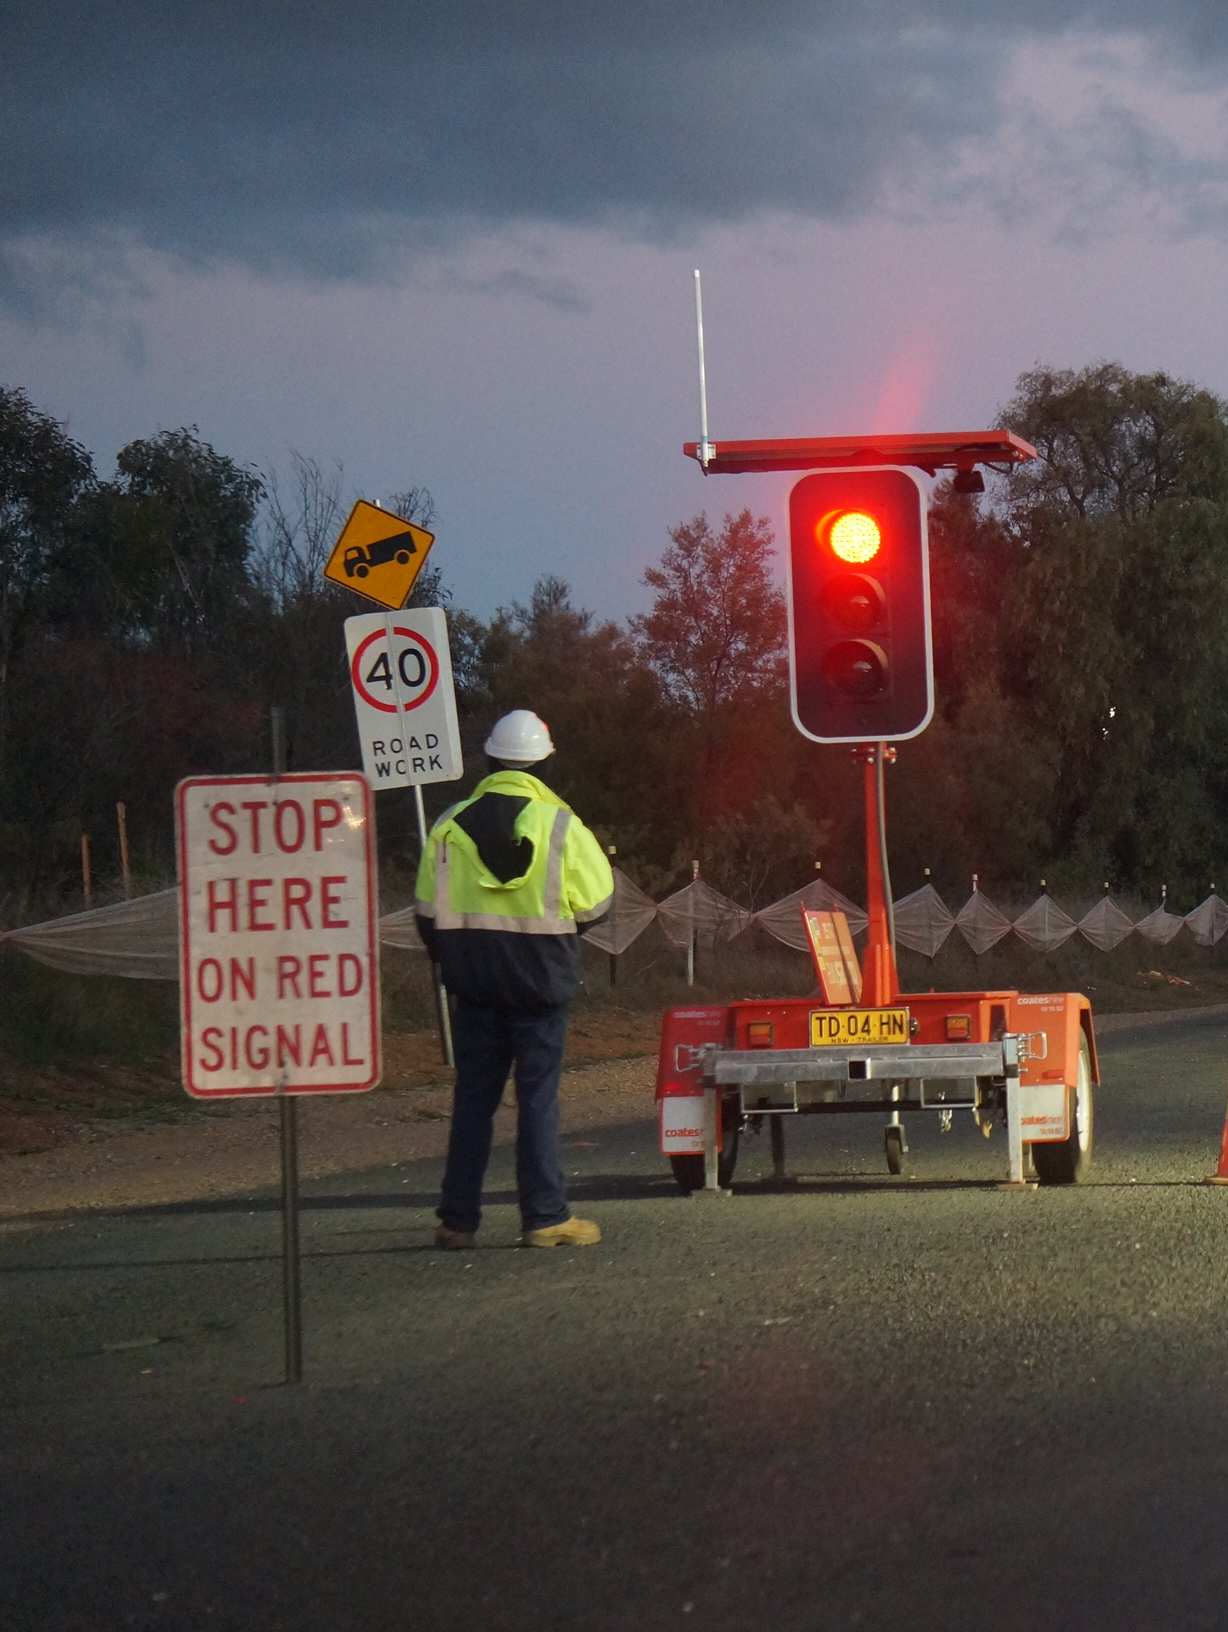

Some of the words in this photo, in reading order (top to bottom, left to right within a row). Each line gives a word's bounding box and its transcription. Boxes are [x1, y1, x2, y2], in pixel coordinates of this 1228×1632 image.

[366, 647, 427, 690] 40
[372, 733, 439, 757] ROAD
[375, 754, 443, 778] WORK
[208, 799, 343, 856] STOP
[207, 875, 350, 933] HERE
[198, 957, 257, 1004] ON
[276, 953, 363, 1000] RED
[199, 1022, 365, 1072] SIGNAL
